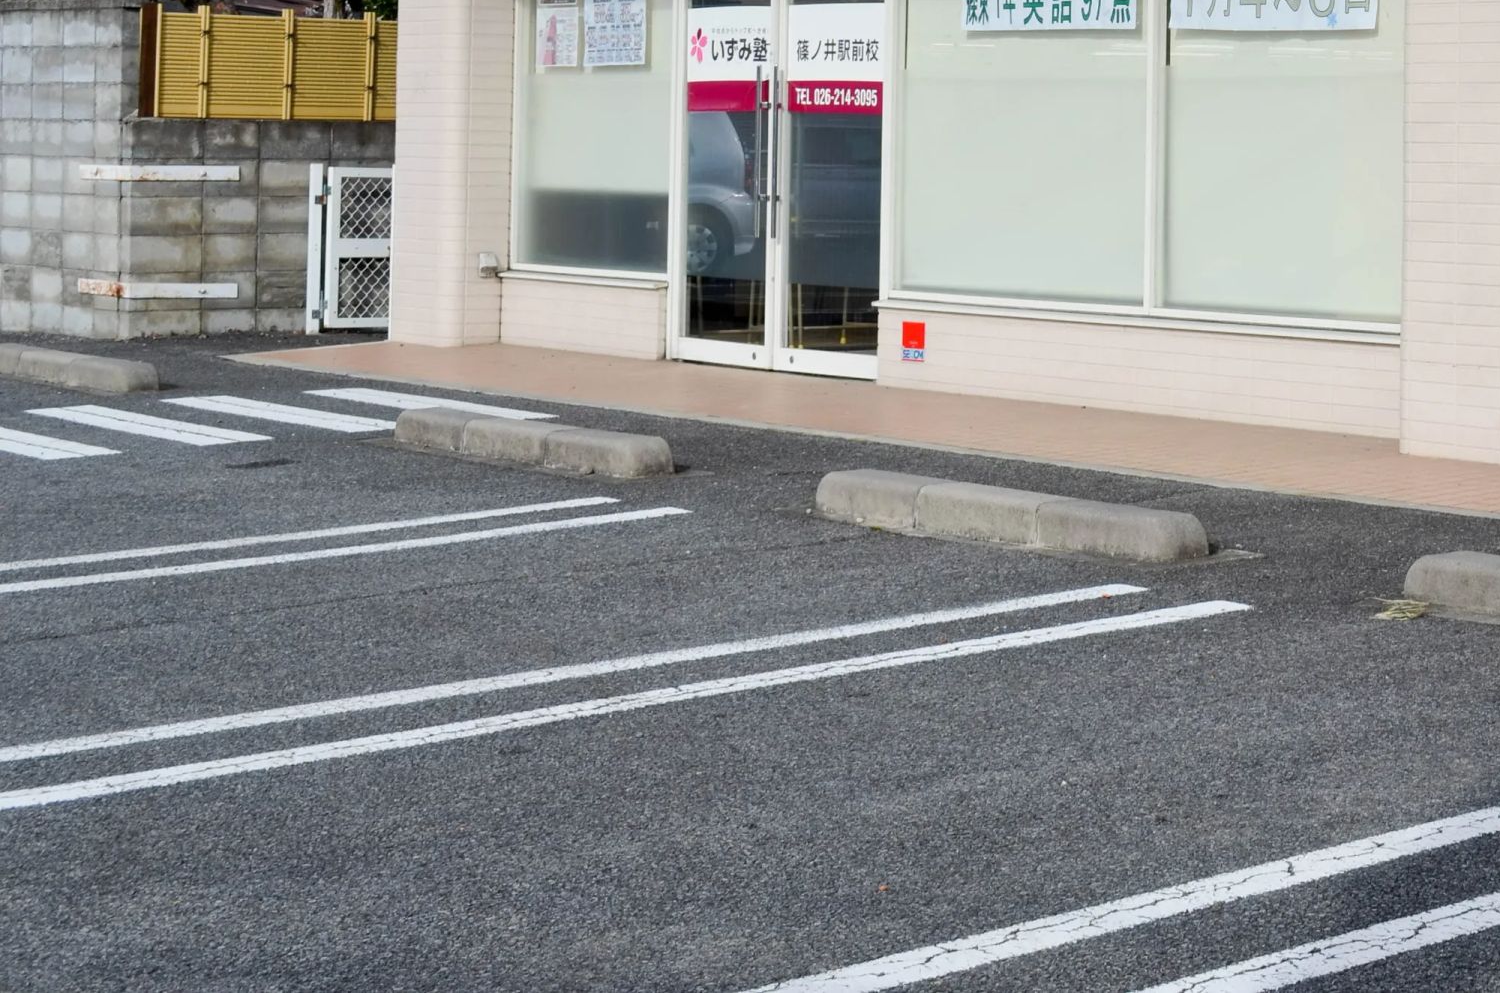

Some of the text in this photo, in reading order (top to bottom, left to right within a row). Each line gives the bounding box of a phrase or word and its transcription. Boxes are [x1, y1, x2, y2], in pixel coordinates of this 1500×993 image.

[796, 38, 880, 62] 篠ノ井駅前校
[795, 87, 878, 107] TEL 026-214-3095
